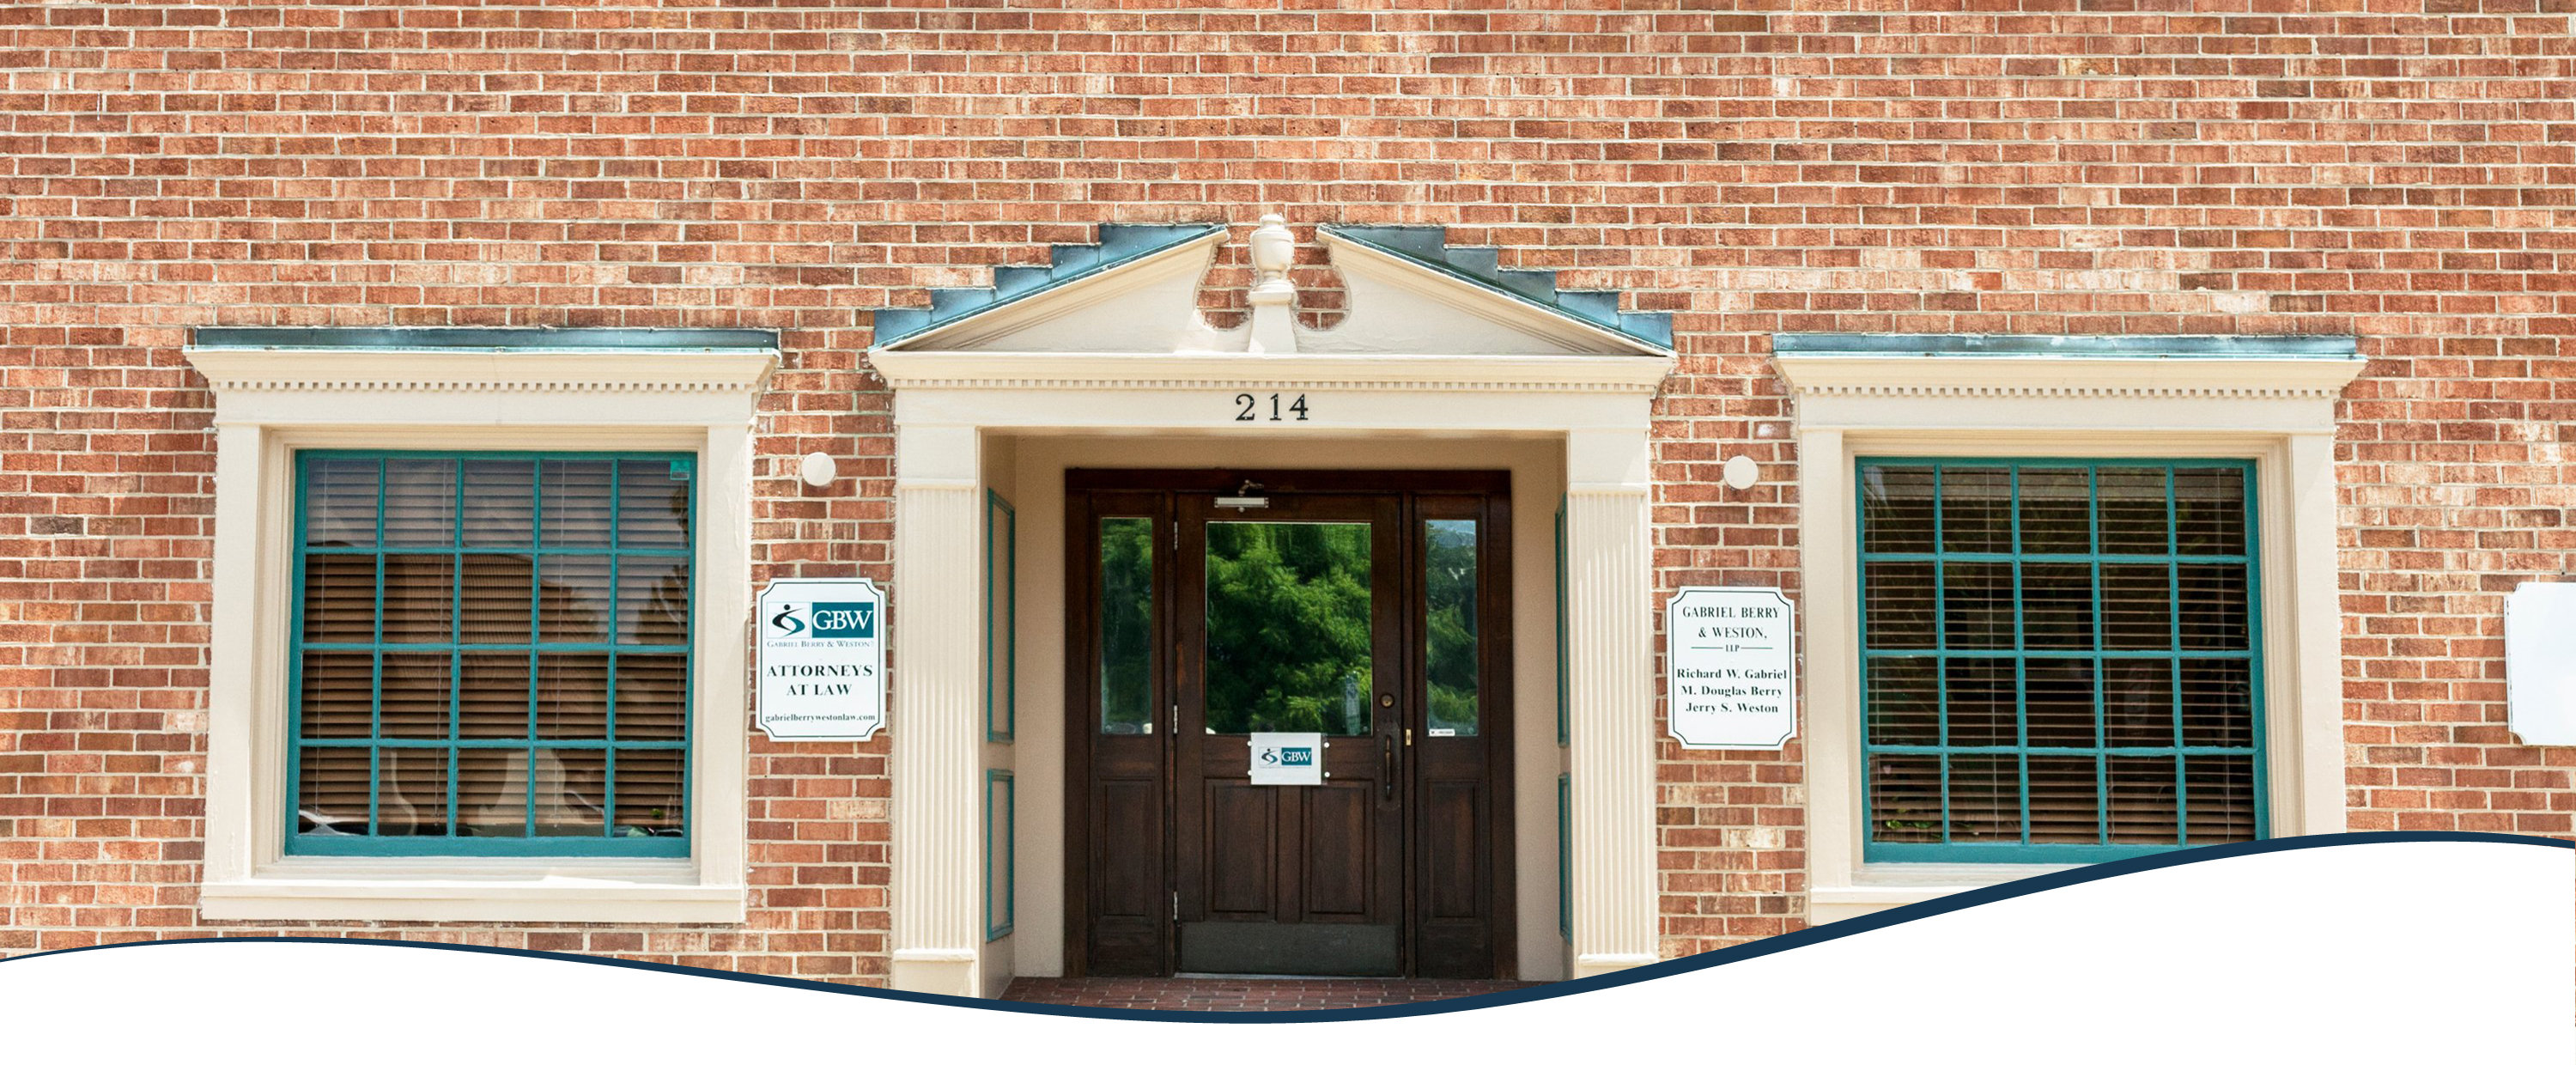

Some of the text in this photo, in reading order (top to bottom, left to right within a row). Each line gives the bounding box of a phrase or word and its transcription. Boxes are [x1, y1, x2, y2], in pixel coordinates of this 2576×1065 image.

[1236, 393, 1309, 421] 214
[1682, 606, 1780, 618] GABRIEL BERRY
[812, 610, 873, 630] GBW
[1698, 627, 1768, 639] & WESTON,
[1725, 644, 1740, 653] LLP
[767, 665, 873, 677] ATTORNEYS
[1677, 668, 1787, 679] Richard W. Gabriel
[787, 685, 853, 696] AT LAW
[1680, 685, 1783, 698] M. Douglas Berry
[1686, 703, 1778, 715] Jerry S. Weston
[765, 714, 876, 723] gabrielberrywestonlaw.com
[1281, 751, 1311, 763] GBW
